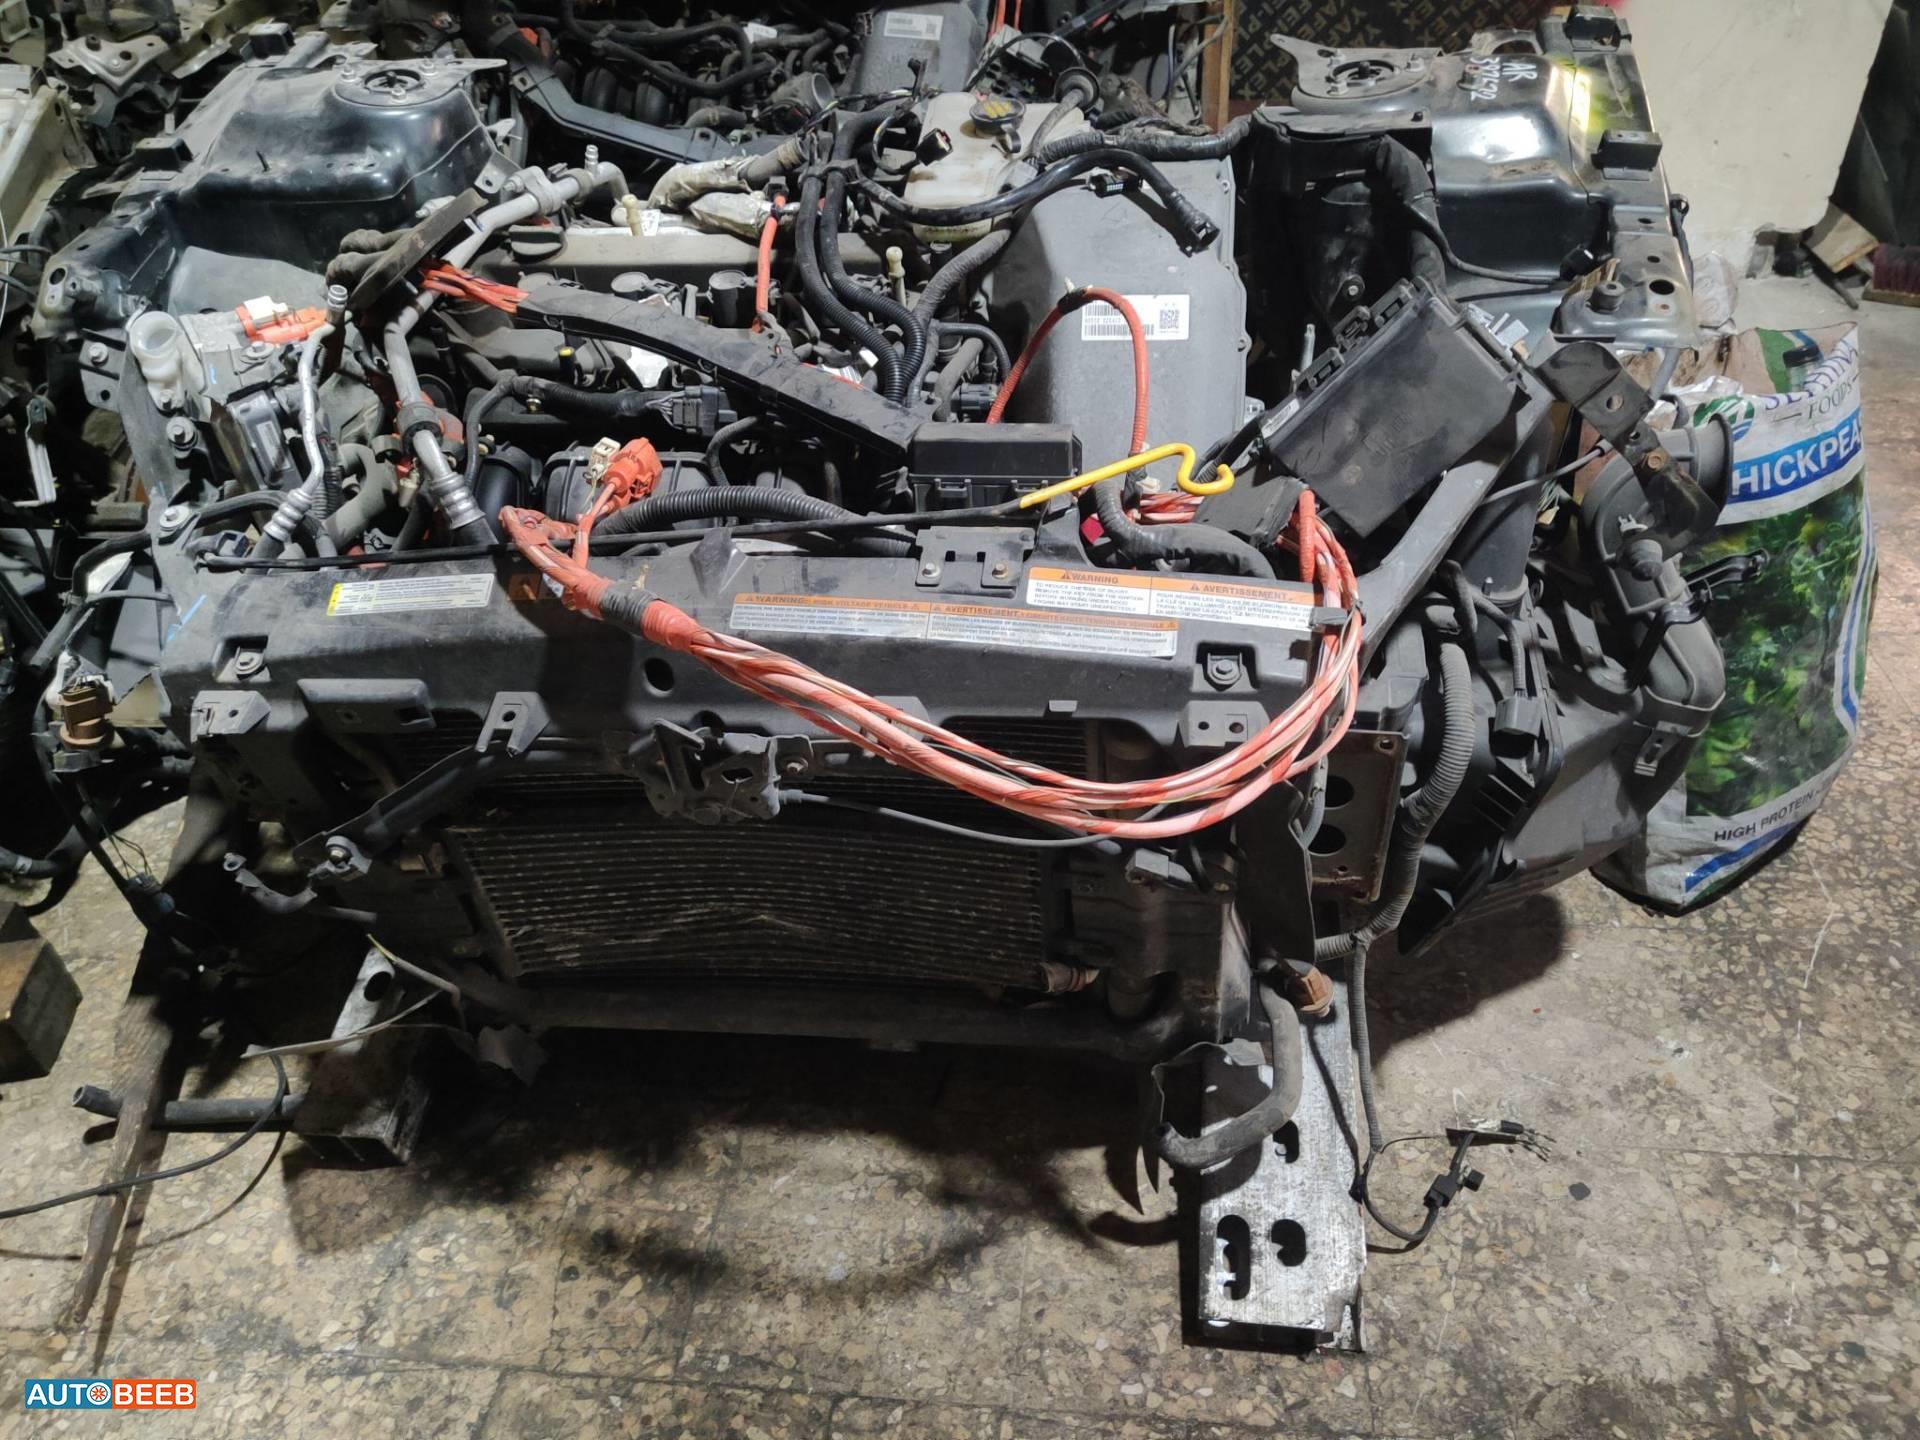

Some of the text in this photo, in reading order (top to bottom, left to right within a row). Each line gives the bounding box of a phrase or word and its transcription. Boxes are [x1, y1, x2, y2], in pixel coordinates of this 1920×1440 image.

[1072, 573, 1119, 584] WARNING
[1714, 791, 1814, 841] HIGH PROTEIN
